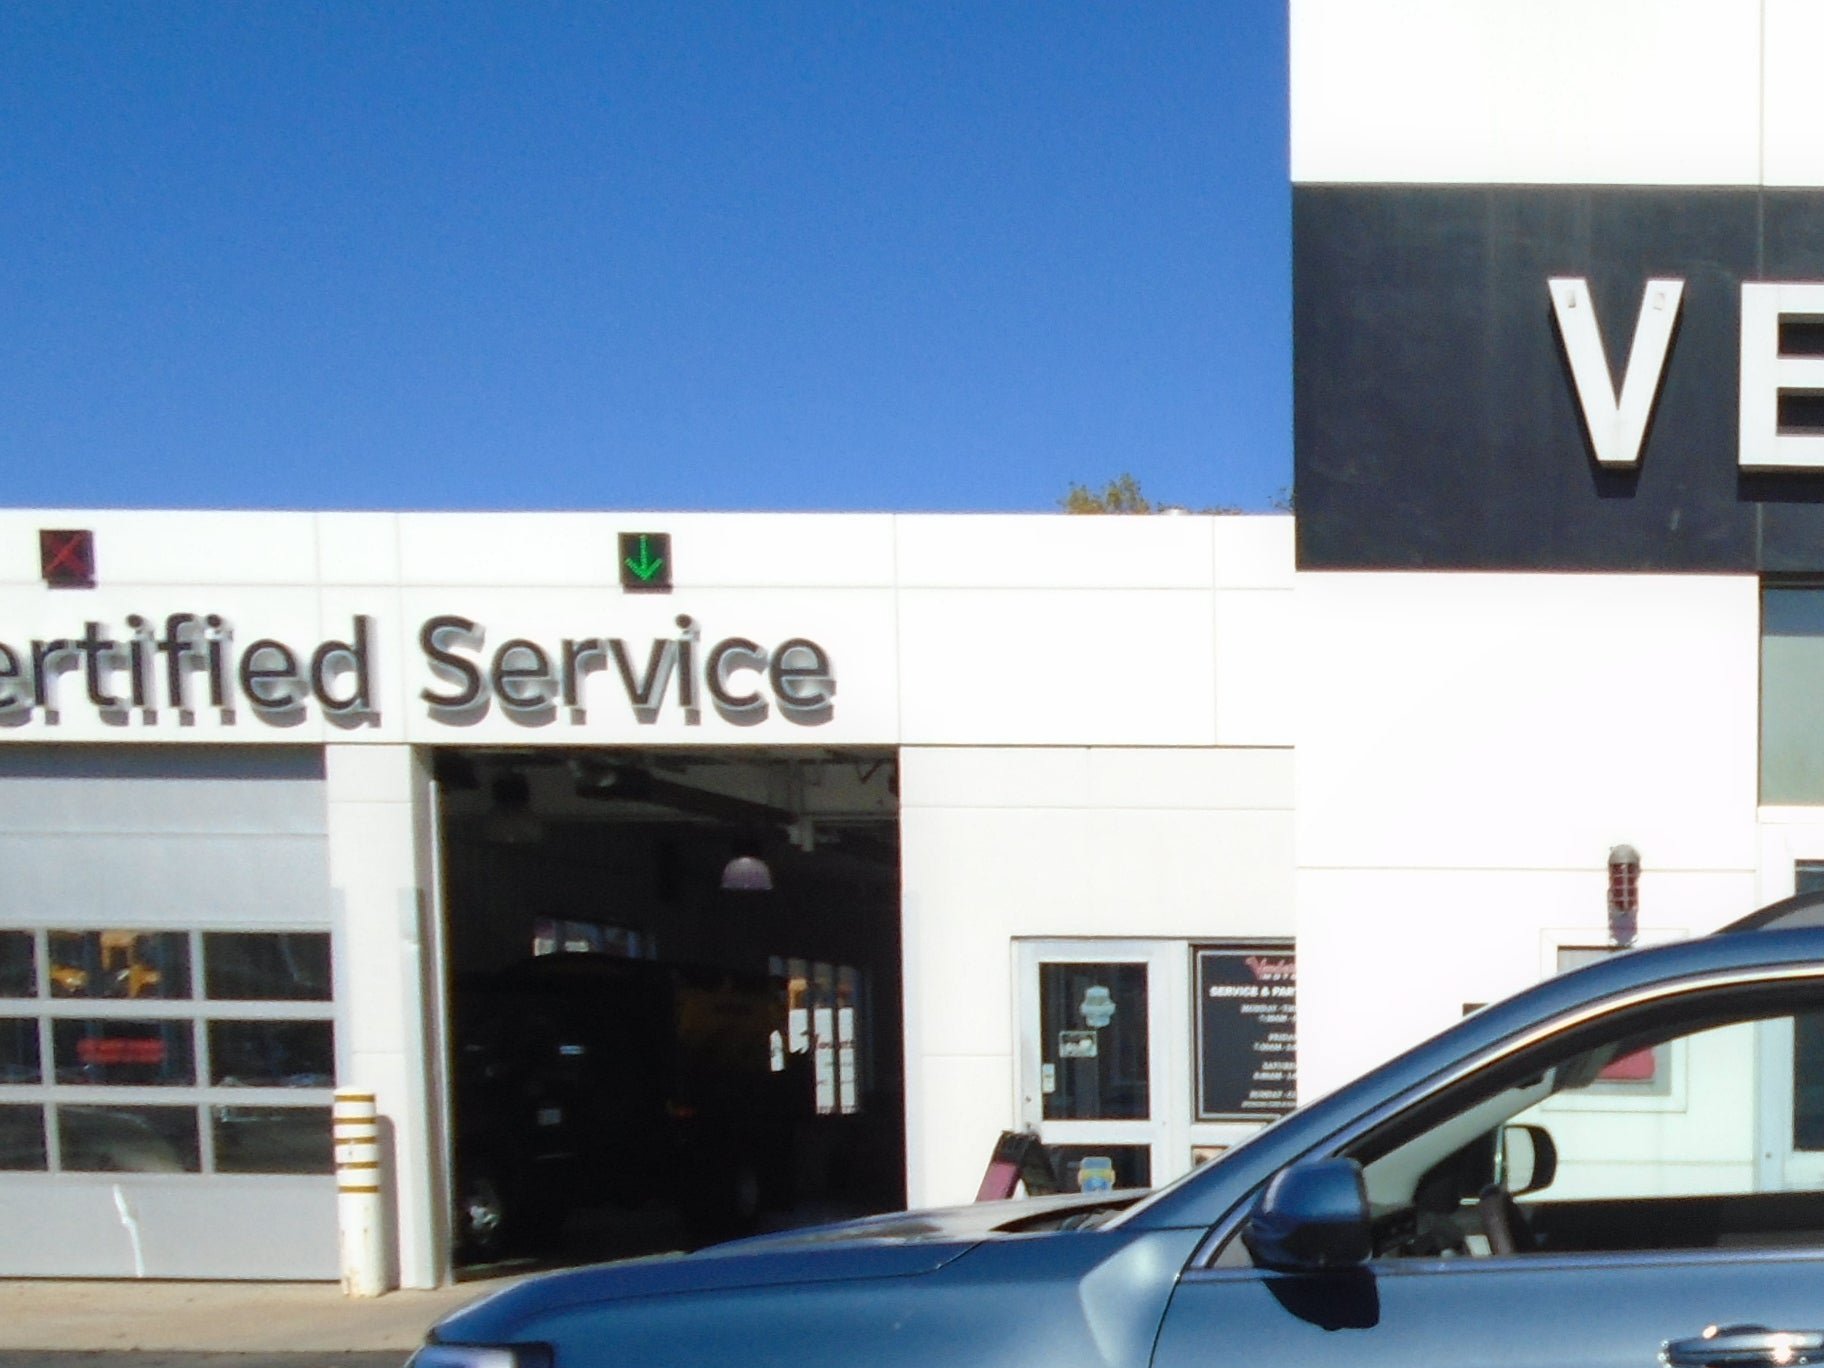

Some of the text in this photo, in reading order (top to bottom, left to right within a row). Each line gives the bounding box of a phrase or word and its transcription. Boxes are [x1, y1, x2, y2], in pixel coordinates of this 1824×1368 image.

[418, 613, 837, 714] Service
[1209, 985, 1259, 998] SERVICE
[1271, 985, 1296, 998] PAR
[1267, 1033, 1296, 1042] FRIDA
